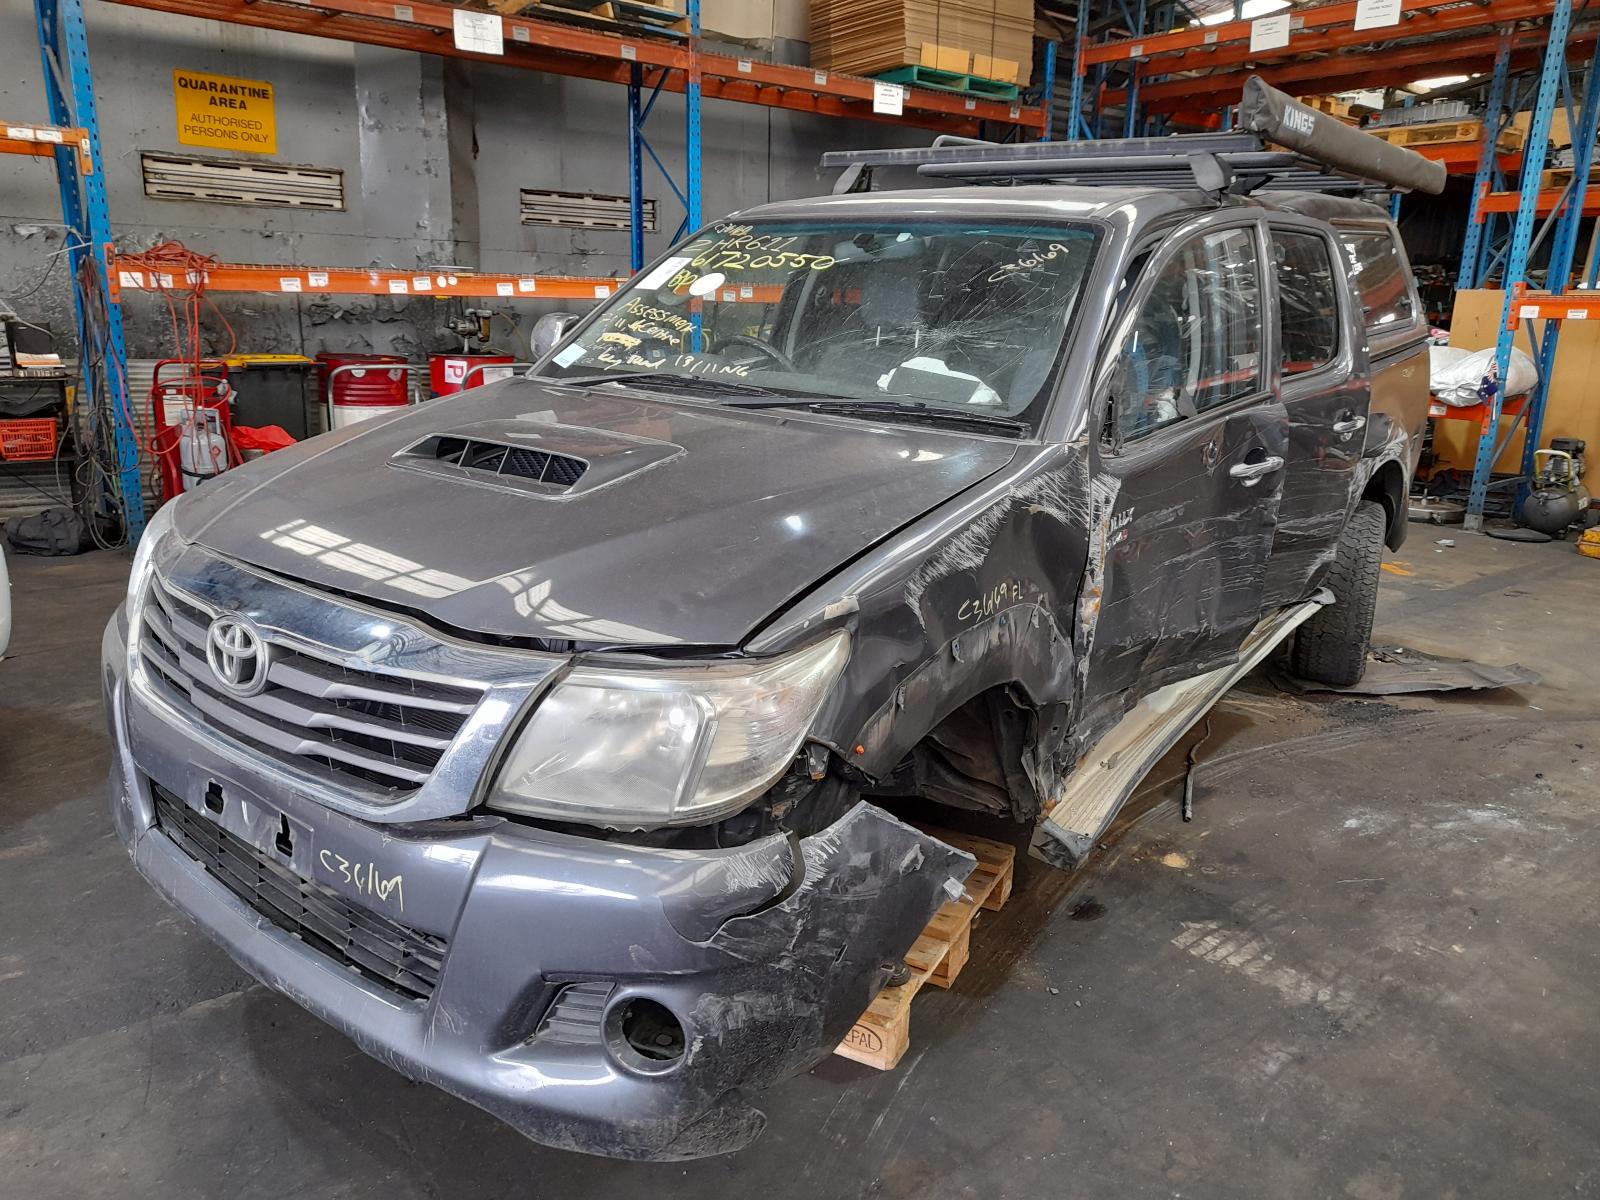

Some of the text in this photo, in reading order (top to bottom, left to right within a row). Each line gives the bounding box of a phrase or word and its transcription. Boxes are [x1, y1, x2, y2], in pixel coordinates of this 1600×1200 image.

[178, 76, 271, 100] QUARANTINE
[208, 95, 248, 111] AREA
[190, 113, 263, 131] AUTHORISED
[1283, 104, 1316, 136] KINGS
[183, 124, 270, 144] PERSONS ONLY
[690, 249, 836, 271] 61720550
[987, 243, 1070, 283] C36169
